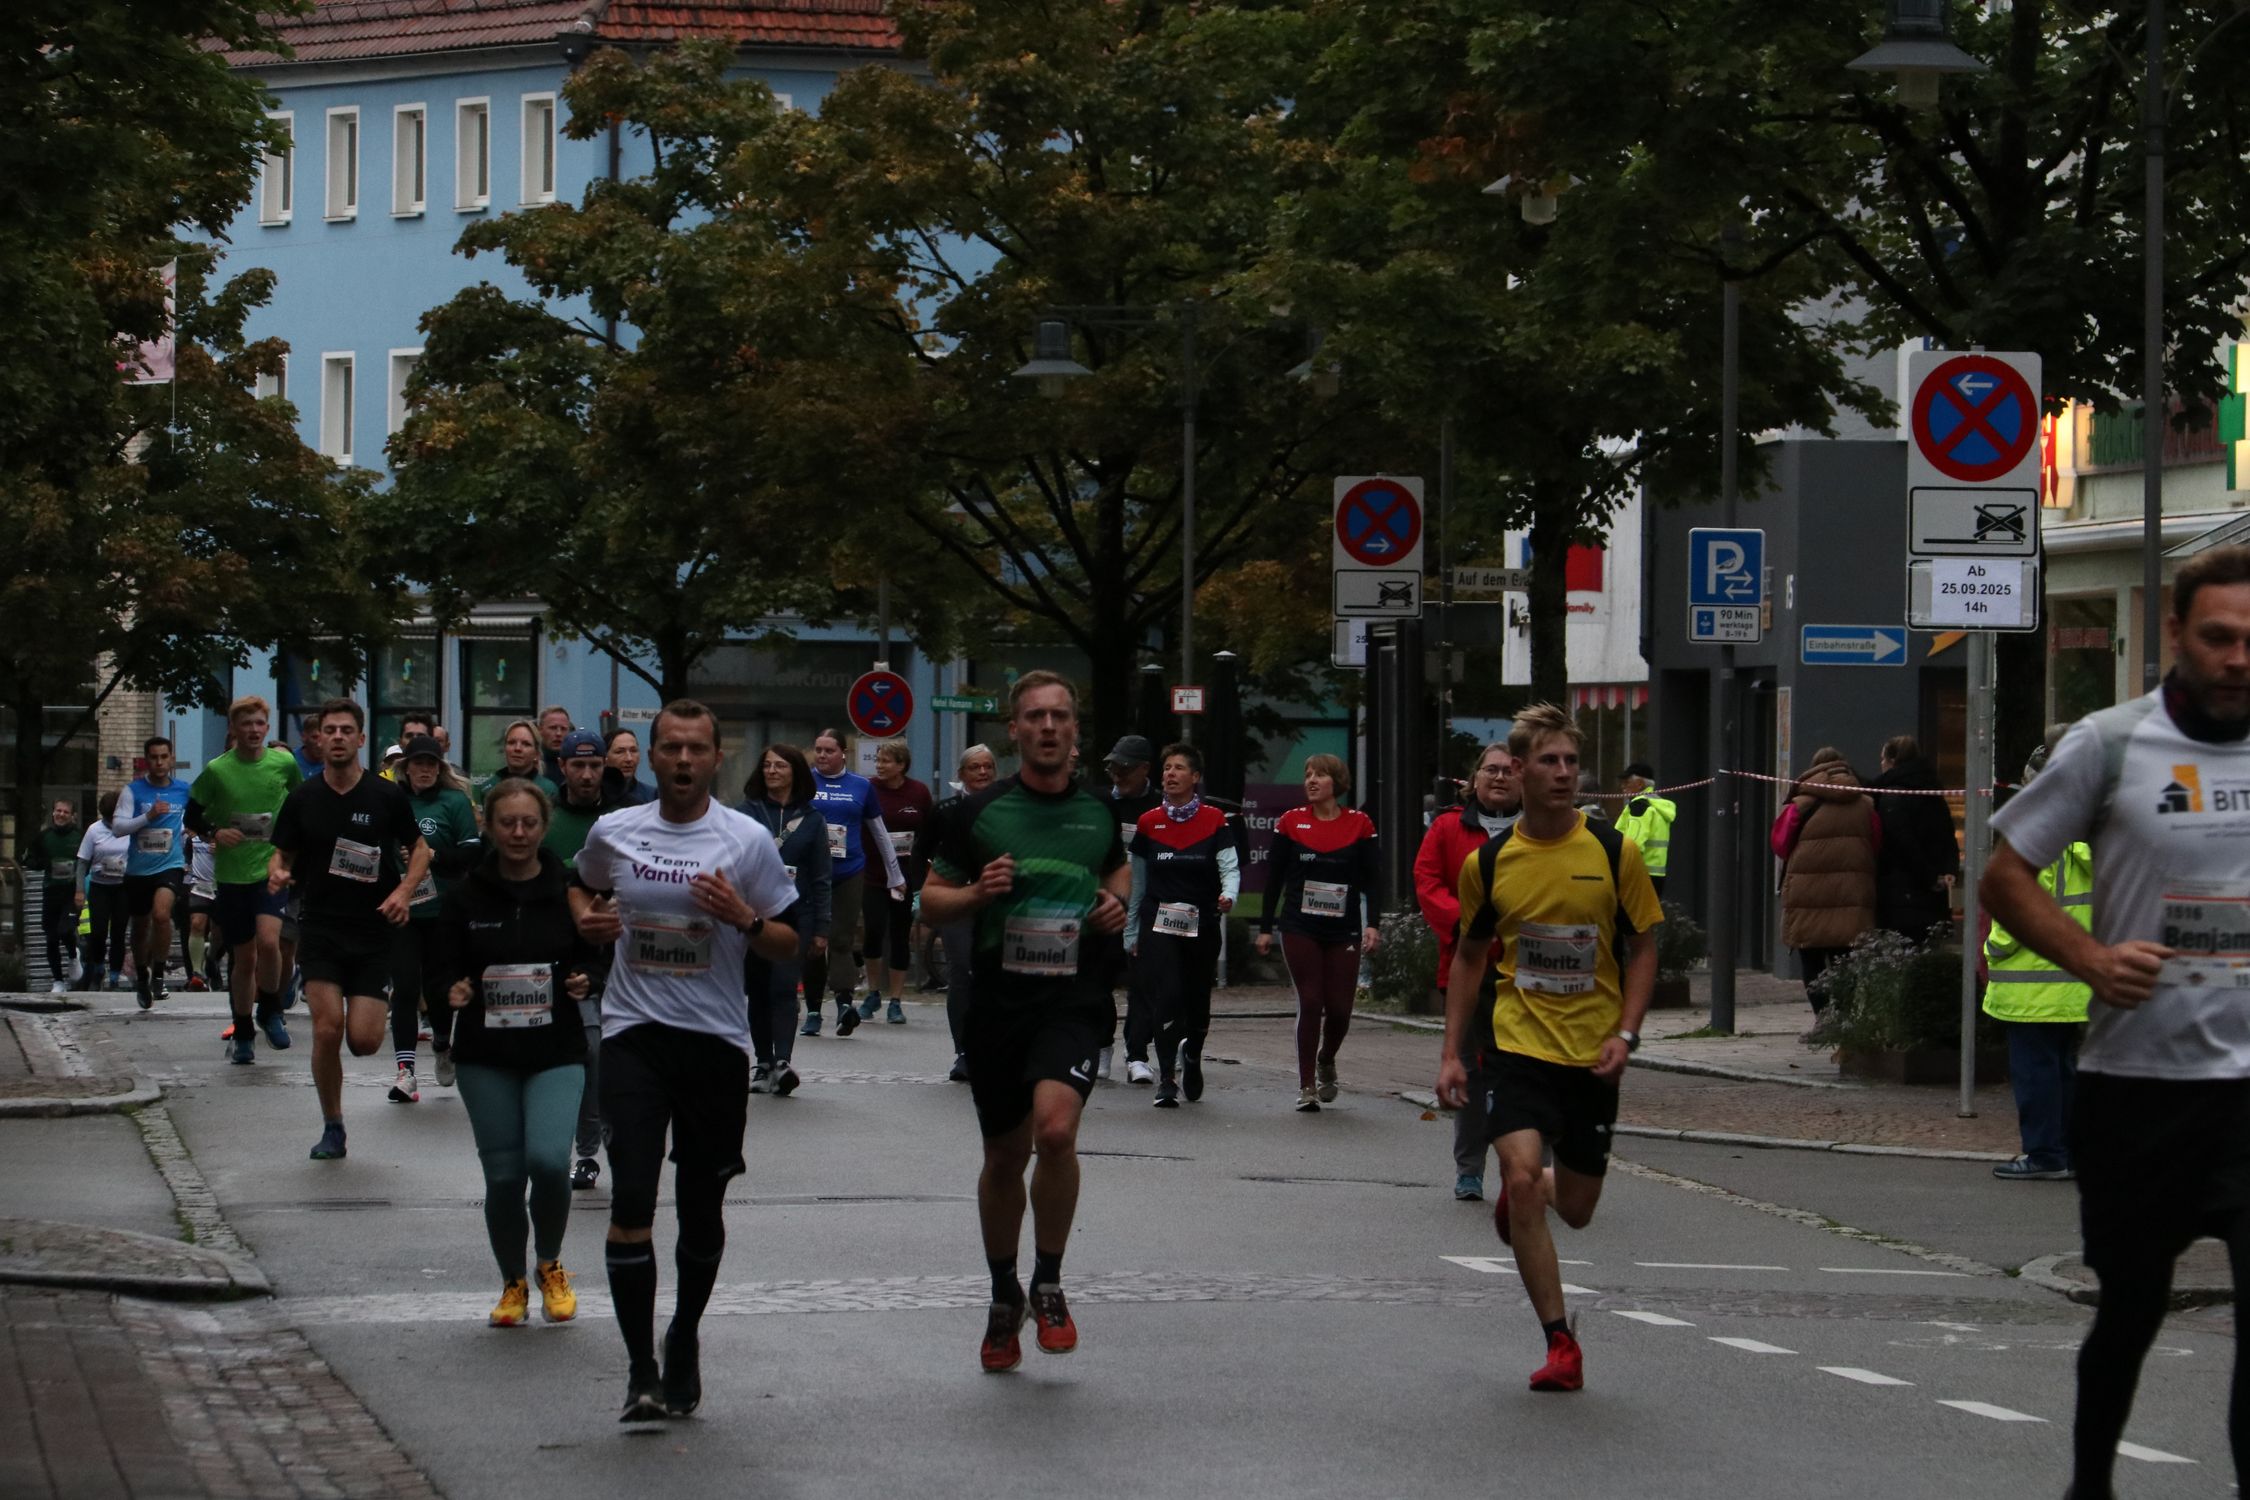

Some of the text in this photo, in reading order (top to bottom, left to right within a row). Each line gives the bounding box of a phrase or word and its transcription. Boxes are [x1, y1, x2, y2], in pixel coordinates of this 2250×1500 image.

[1967, 565, 1986, 577] Ab
[1458, 573, 1530, 588] Auf dem Gra
[1941, 582, 2012, 595] 25.09.2025
[1964, 602, 1988, 613] 14h
[1721, 610, 1753, 620] 90 Min
[1808, 640, 1876, 650] Einbahnstraße
[1242, 798, 1258, 808] les
[351, 812, 371, 823] AKE
[652, 855, 700, 868] Team
[1157, 852, 1174, 861] HIPP
[338, 858, 373, 876] Sigurd
[632, 863, 701, 884] Vantiv
[1308, 898, 1340, 911] Verena
[1163, 917, 1189, 930] Britta
[2165, 926, 2250, 955] Benjam
[640, 943, 697, 963] Martin
[1015, 947, 1067, 963] Daniel
[1528, 951, 1582, 970] Moritz
[1562, 983, 1585, 994] 1817
[487, 991, 547, 1006] Stefanie
